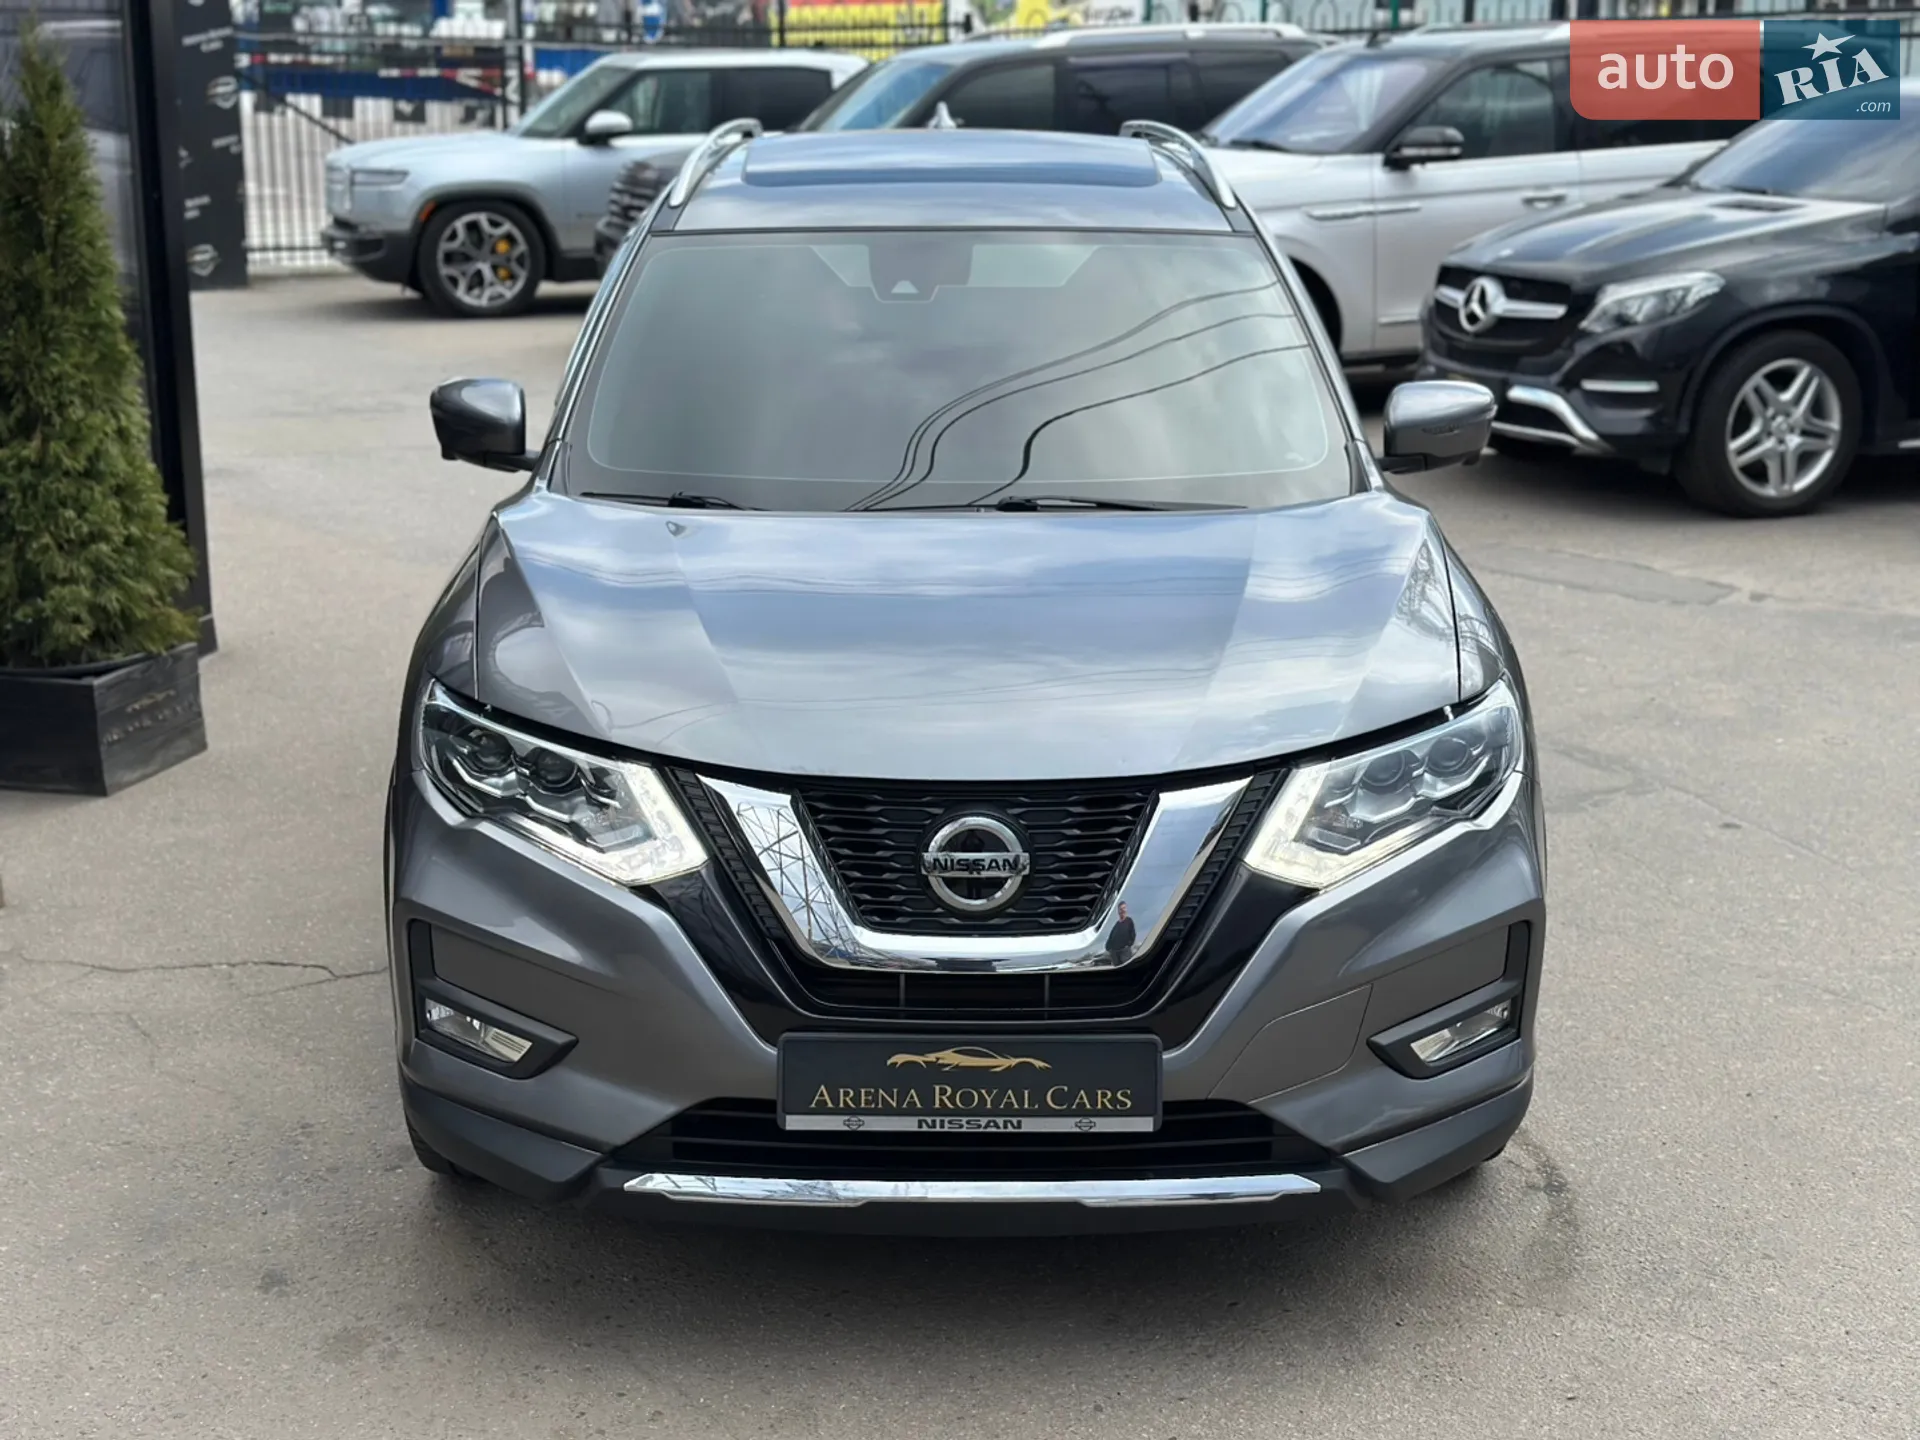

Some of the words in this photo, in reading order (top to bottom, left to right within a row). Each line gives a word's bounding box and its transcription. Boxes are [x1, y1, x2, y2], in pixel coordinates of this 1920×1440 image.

[932, 857, 1019, 872] NISSAN
[809, 1084, 922, 1109] ARENA
[932, 1084, 1038, 1110] ROYAL
[1045, 1085, 1133, 1110] CARS
[917, 1118, 1022, 1130] NISSAN
